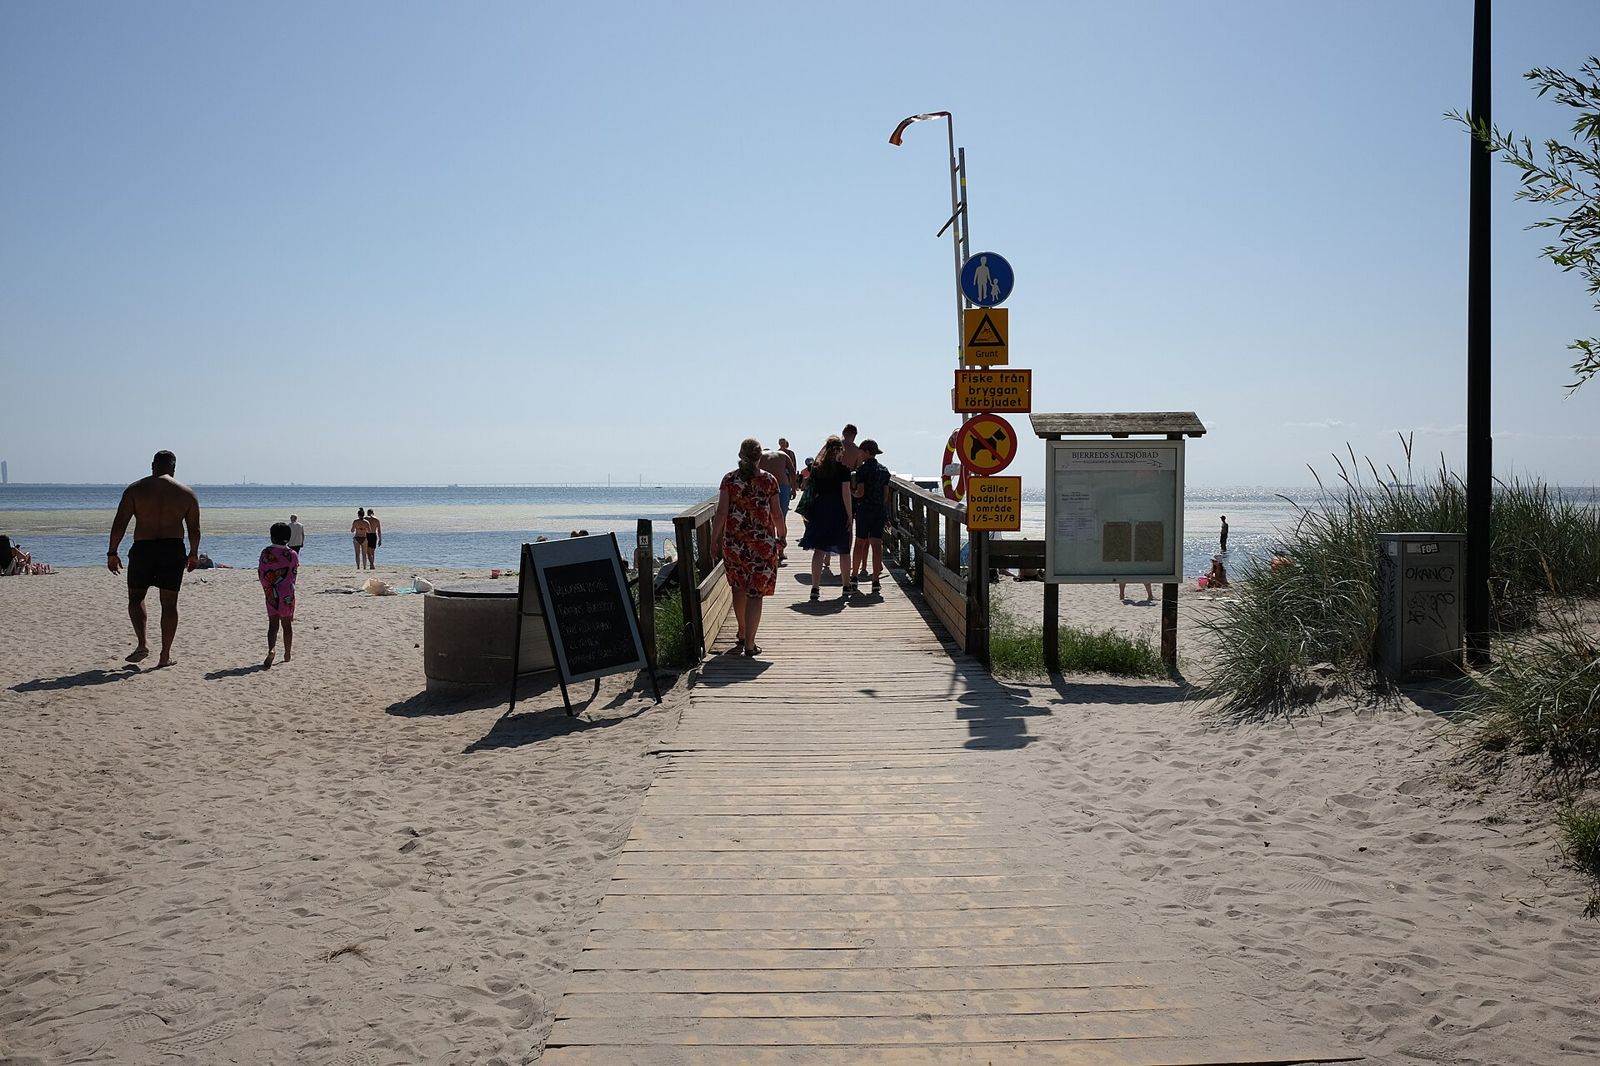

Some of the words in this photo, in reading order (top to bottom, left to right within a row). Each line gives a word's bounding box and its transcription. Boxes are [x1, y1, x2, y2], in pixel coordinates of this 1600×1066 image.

[975, 350, 999, 358] Grunt
[961, 373, 993, 383] Fiske
[1000, 373, 1025, 383] från
[968, 385, 1018, 396] bryggan
[964, 397, 1022, 408] förbjudet
[979, 484, 1009, 493] Gäller
[970, 494, 1017, 504] badplats-
[975, 504, 1013, 513] område
[972, 514, 1015, 522] 1/5-31/8
